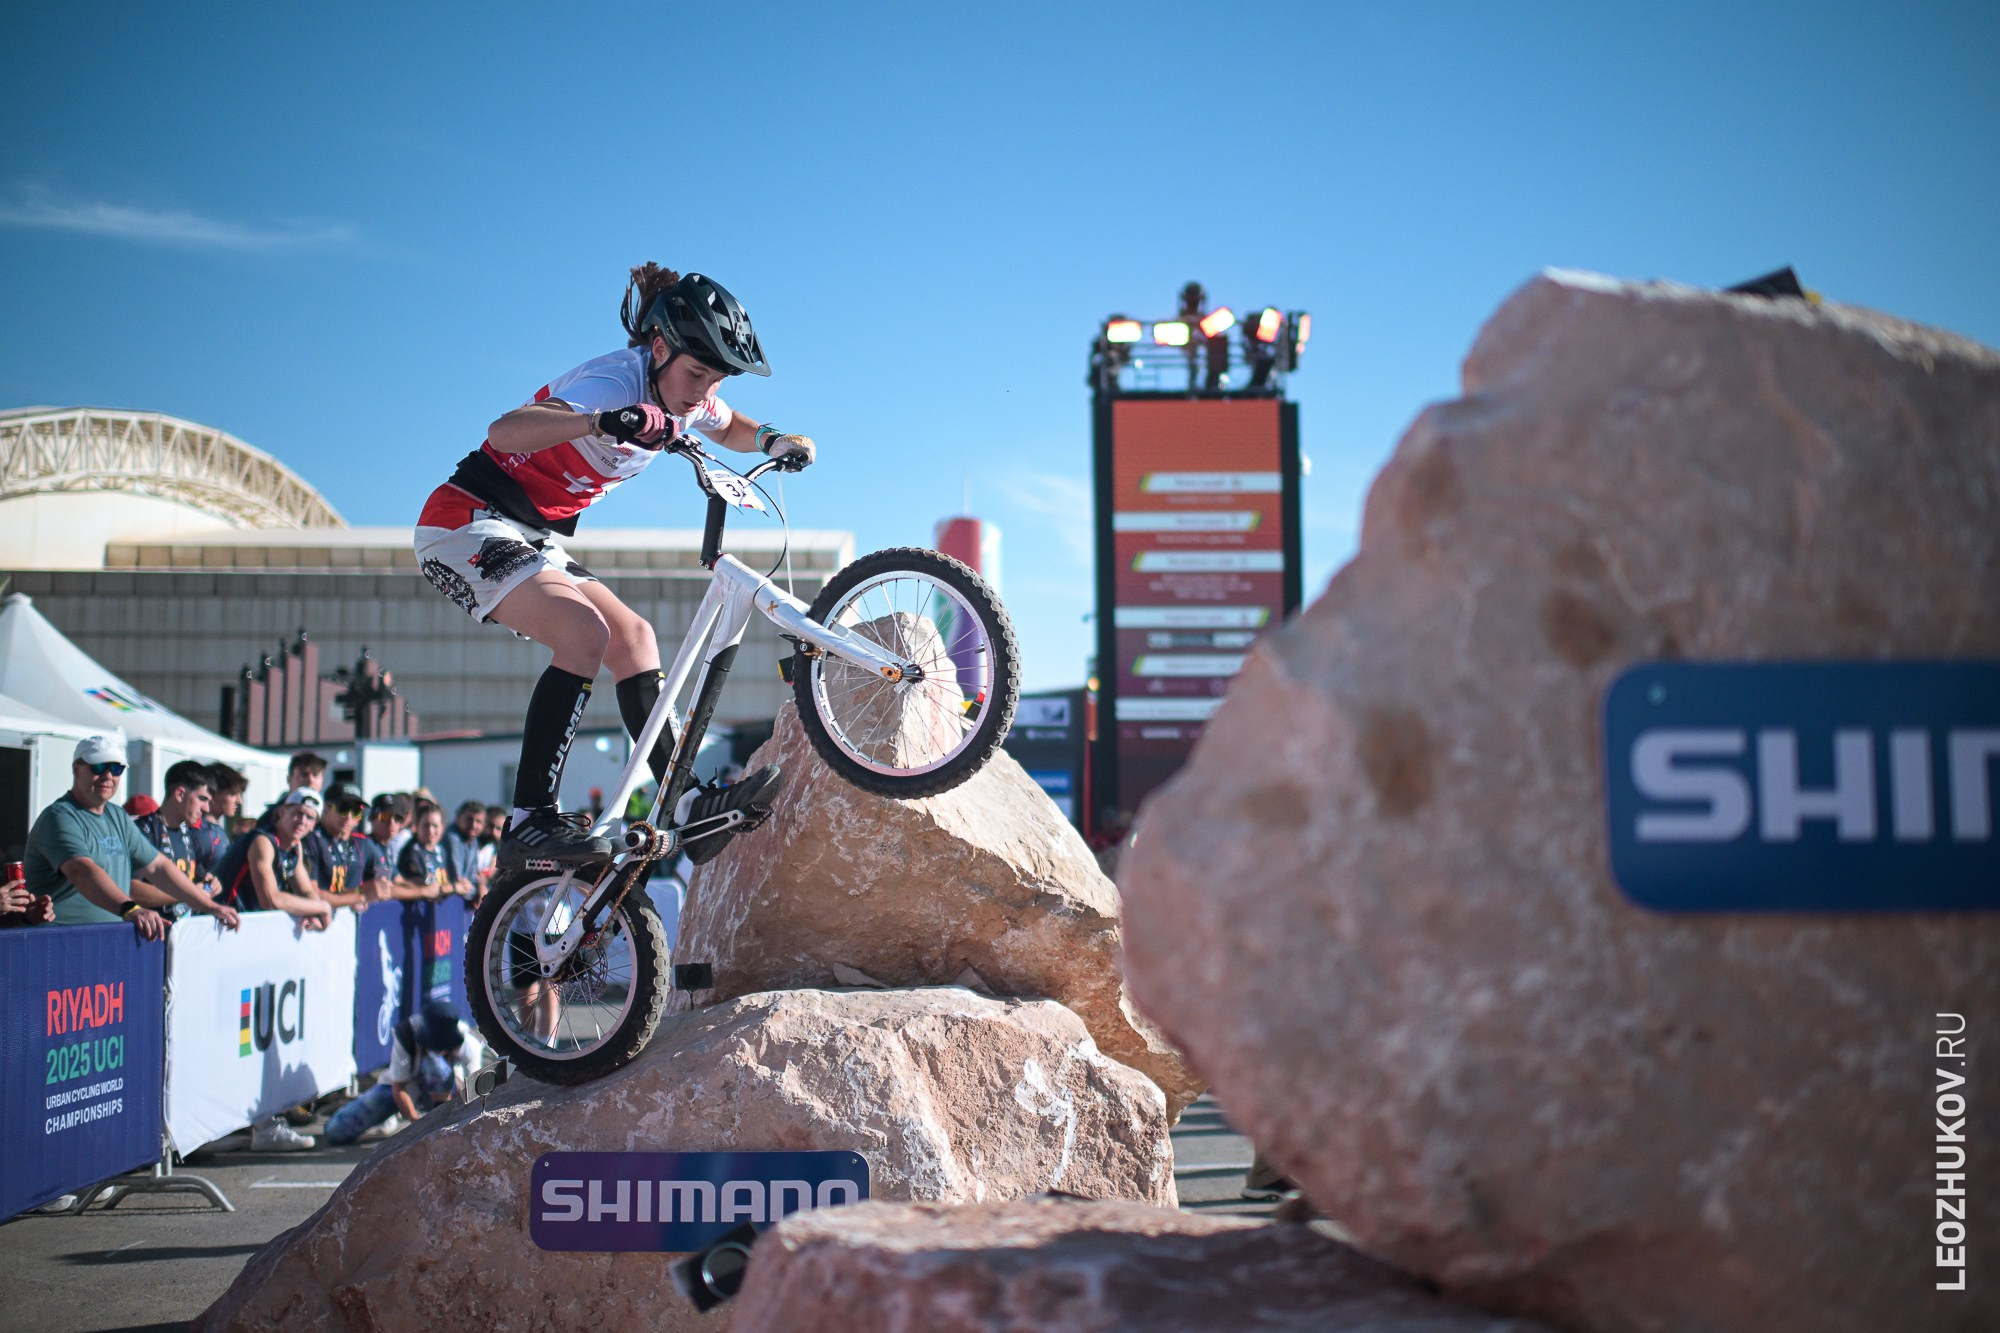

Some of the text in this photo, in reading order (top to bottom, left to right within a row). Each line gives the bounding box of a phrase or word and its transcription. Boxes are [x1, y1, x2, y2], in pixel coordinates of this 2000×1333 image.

[47, 981, 124, 1037] RIYADH
[253, 977, 305, 1053] UCI
[46, 1035, 124, 1085] 2025 UCI
[45, 1097, 123, 1135] CHAMPIONSHIPS
[46, 1077, 124, 1110] URBAN CYCLING WORLD
